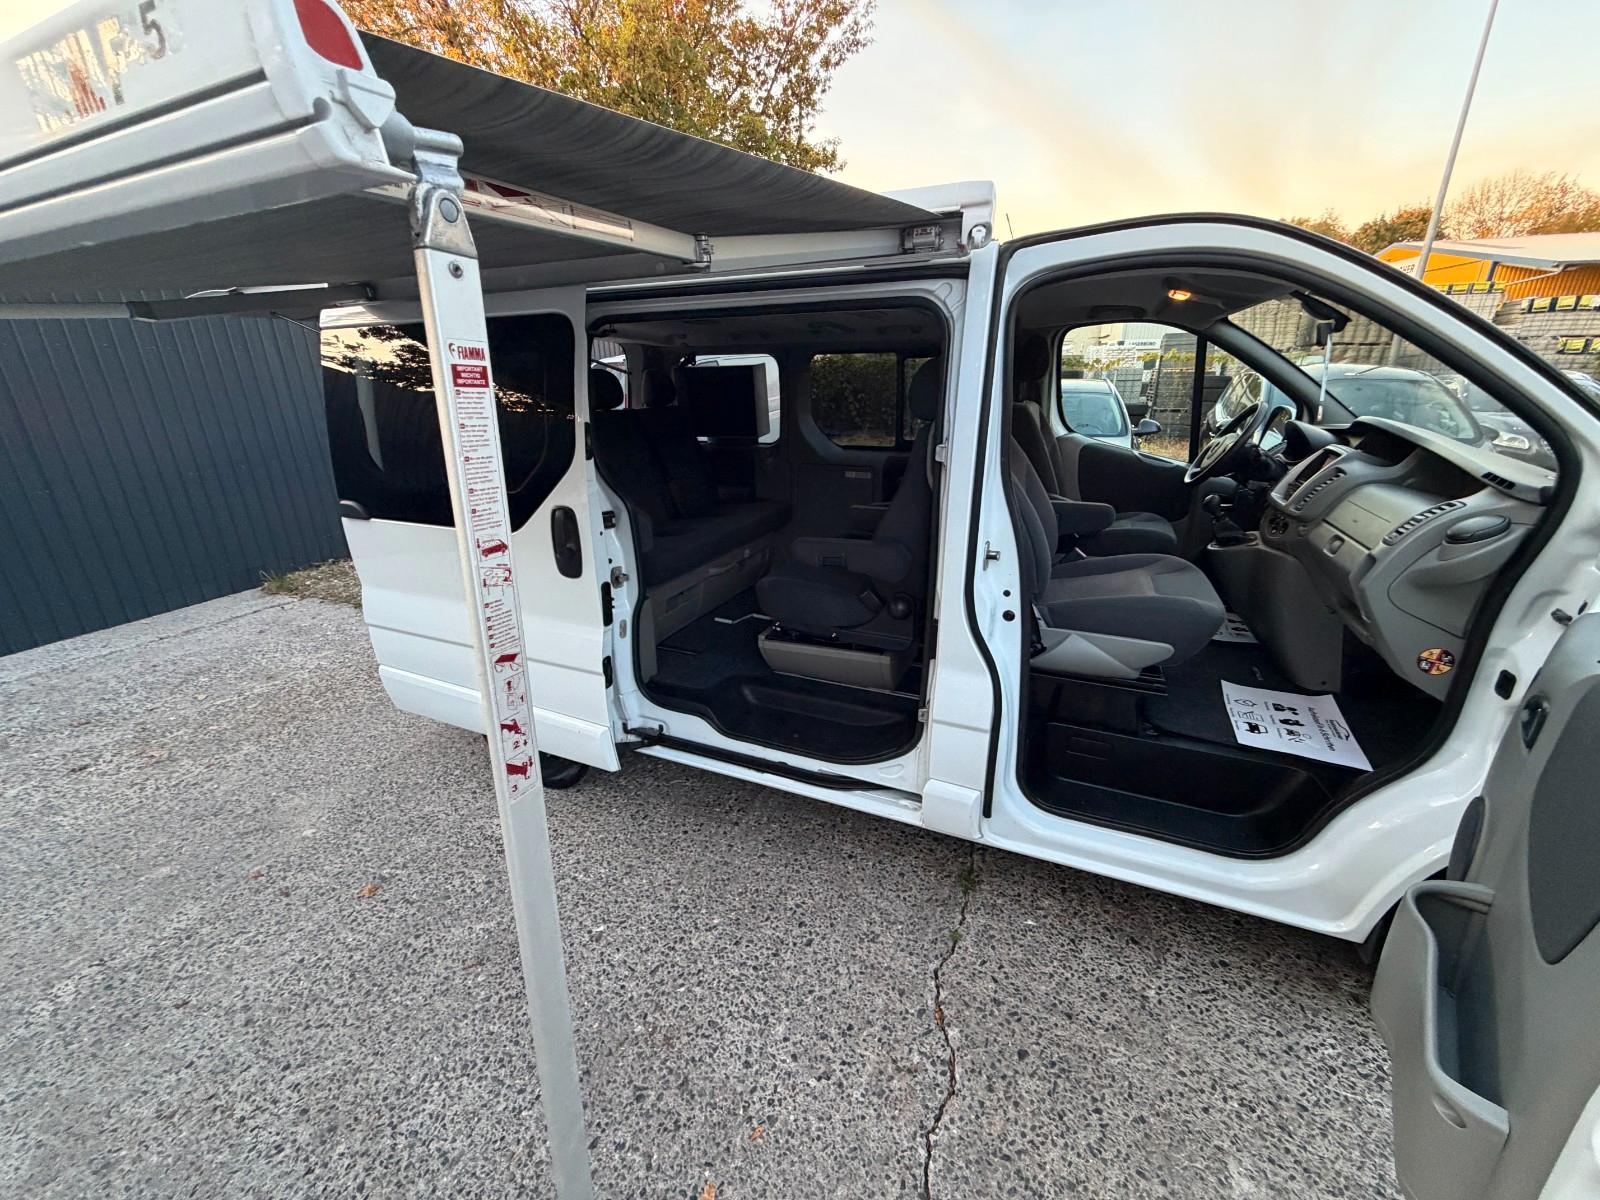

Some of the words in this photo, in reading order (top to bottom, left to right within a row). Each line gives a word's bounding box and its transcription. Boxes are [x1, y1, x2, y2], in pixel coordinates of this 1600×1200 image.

[457, 345, 486, 361] FIAMMA
[513, 740, 520, 749] 2
[511, 784, 518, 793] 3
